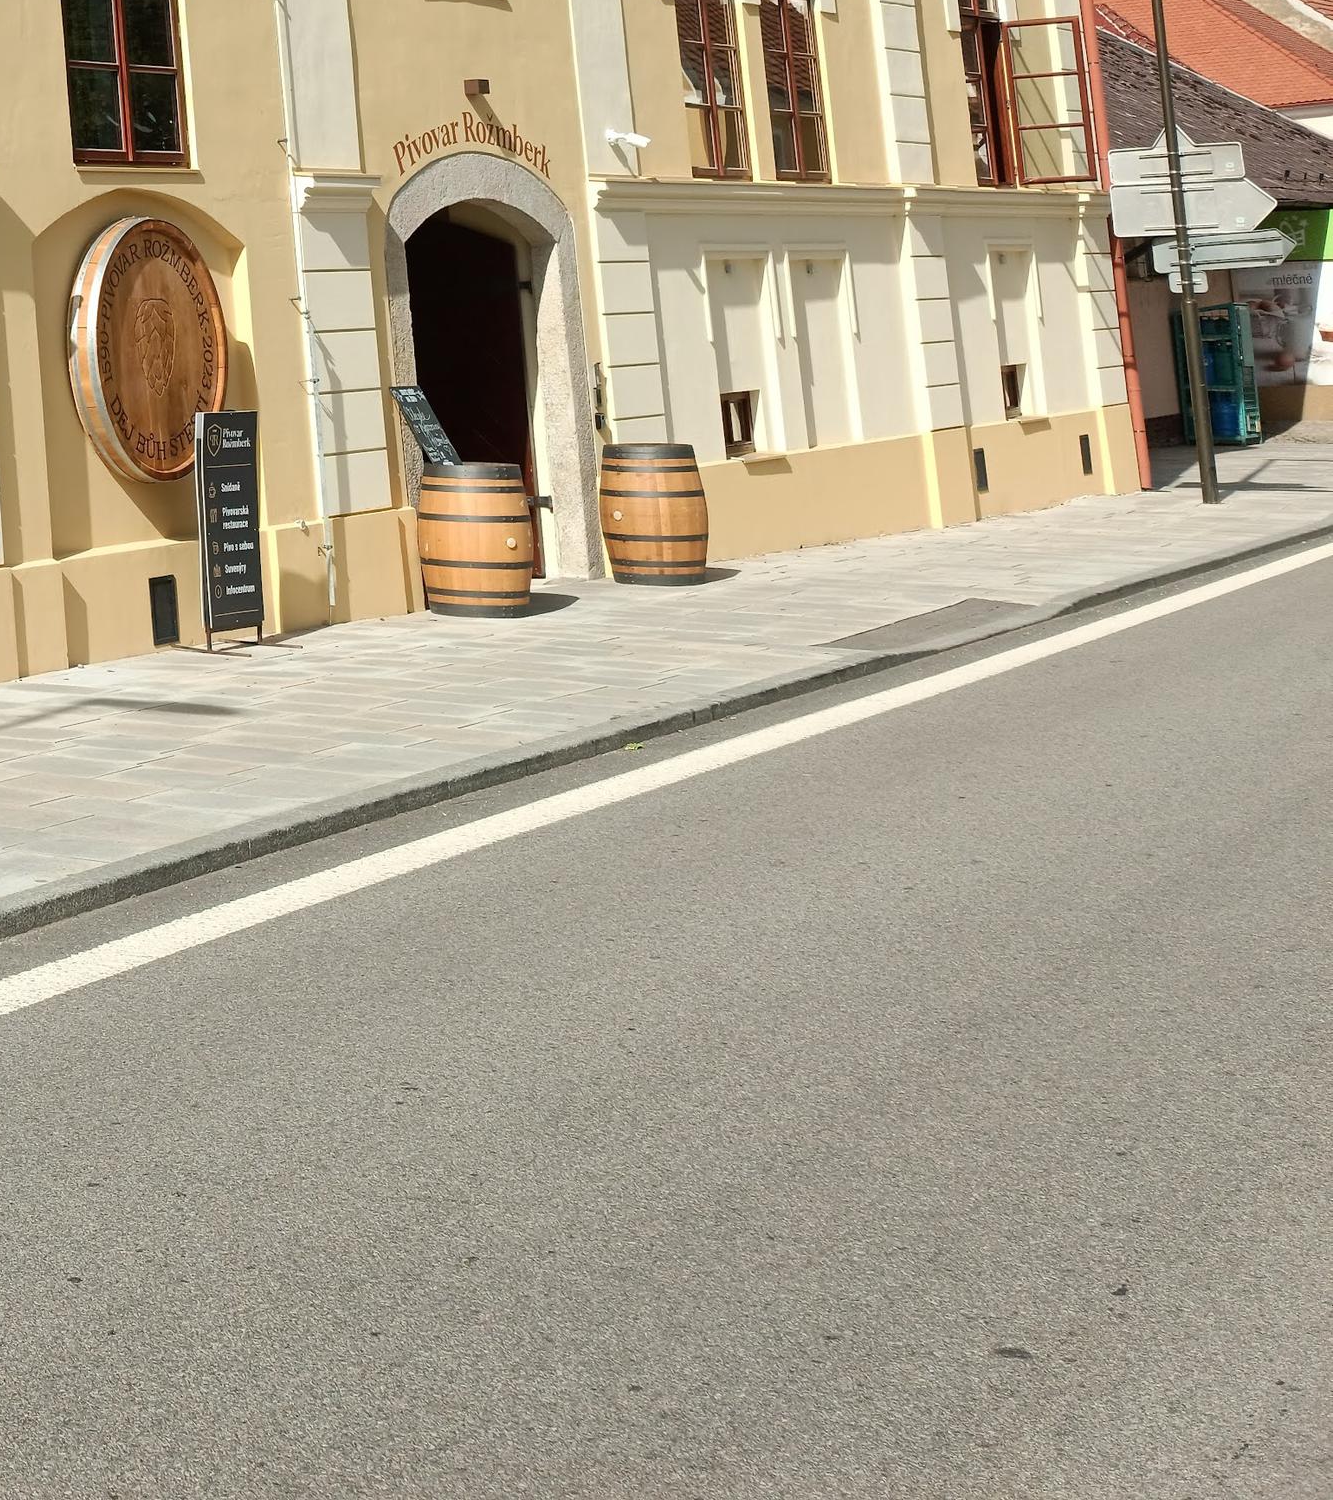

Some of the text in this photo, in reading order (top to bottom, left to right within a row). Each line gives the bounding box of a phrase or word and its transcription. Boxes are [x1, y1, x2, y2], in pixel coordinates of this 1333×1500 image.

[393, 111, 551, 179] Pivovar Rožmberk
[110, 393, 134, 440] DEJ
[135, 433, 167, 460] BŮH
